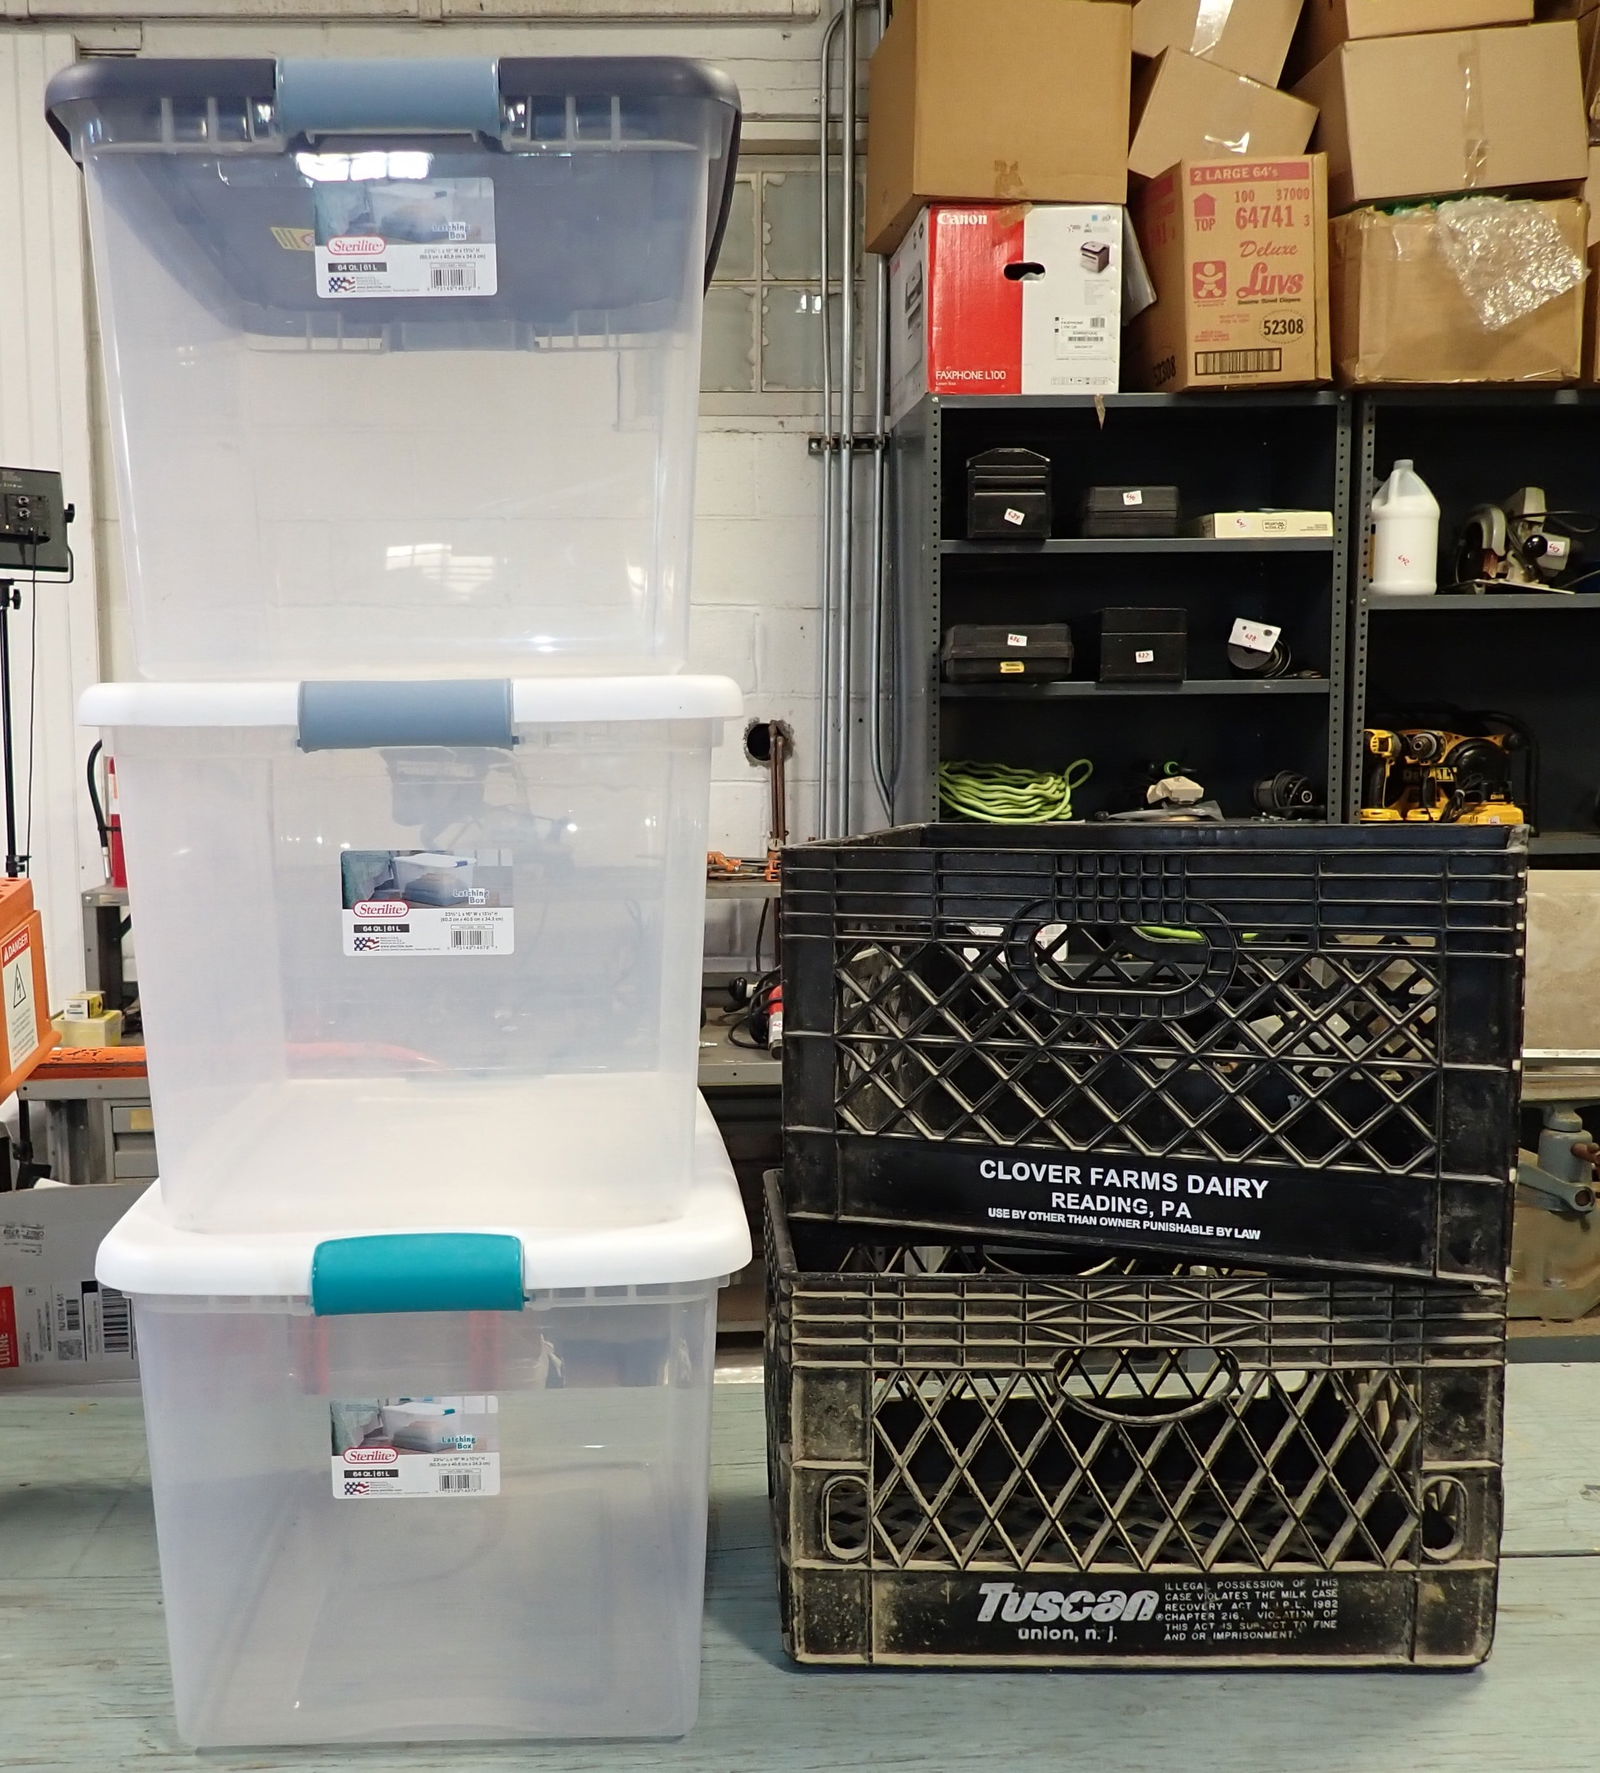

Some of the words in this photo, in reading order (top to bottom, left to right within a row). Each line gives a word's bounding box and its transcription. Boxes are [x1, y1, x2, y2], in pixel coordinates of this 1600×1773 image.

[1194, 170, 1202, 182] 2
[1206, 167, 1250, 180] LARGE
[1234, 190, 1255, 203] 100
[1276, 188, 1310, 201] 37000
[936, 212, 988, 225] Canon
[1235, 204, 1294, 230] 64741
[1303, 214, 1310, 226] 3
[1194, 218, 1216, 232] TOP
[334, 240, 378, 252] Sterilite
[1240, 240, 1298, 258] Deluxe
[1236, 262, 1305, 299] Luvs
[1263, 318, 1304, 336] 52308
[936, 370, 984, 380] FAXPHONE
[985, 370, 1006, 380] L100
[360, 904, 403, 914] Sterilite
[8, 932, 28, 956] DANGER
[980, 1159, 1082, 1186] CLOVER
[1090, 1168, 1178, 1192] FARMS
[1187, 1174, 1269, 1199] DAIRY
[1051, 1192, 1154, 1218] READING,
[1162, 1200, 1192, 1218] PA
[988, 1207, 1010, 1219] USE
[1012, 1209, 1028, 1220] BY
[1028, 1210, 1066, 1223] OTHER
[1067, 1214, 1097, 1226] THAN
[1100, 1216, 1141, 1230] OWNER
[1142, 1220, 1214, 1236] PUNISHABLE
[1216, 1226, 1232, 1238] BY
[1234, 1228, 1260, 1240] LAW
[442, 1436, 476, 1444] Latching
[350, 1450, 392, 1461] Sterilite
[1164, 1582, 1211, 1591] ILLEGAL
[1216, 1580, 1284, 1590] POSSESSION
[1292, 1578, 1306, 1588] OF
[1314, 1578, 1339, 1587] THIS
[976, 1582, 1160, 1622] Tuscan
[1164, 1592, 1192, 1601] CASE
[1198, 1591, 1249, 1601] VIOLATES
[1255, 1590, 1276, 1600] THE
[1281, 1590, 1307, 1598] MILK
[1312, 1589, 1338, 1598] CASE
[1231, 1601, 1252, 1610] ACT
[1314, 1600, 1338, 1608] 1982
[1164, 1612, 1216, 1622] CHAPTER
[1221, 1612, 1244, 1621] 216.
[1323, 1609, 1339, 1618] OF
[1165, 1622, 1188, 1631] THIS
[1194, 1622, 1215, 1631] ACT
[1222, 1622, 1232, 1630] IS
[1313, 1620, 1338, 1629] FINE
[1018, 1626, 1079, 1642] union,
[1085, 1628, 1101, 1640] n.
[1107, 1626, 1118, 1643] j.
[1164, 1632, 1186, 1641] AND
[1191, 1632, 1207, 1640] OR
[1212, 1630, 1298, 1640] IMPRISONMENT.
